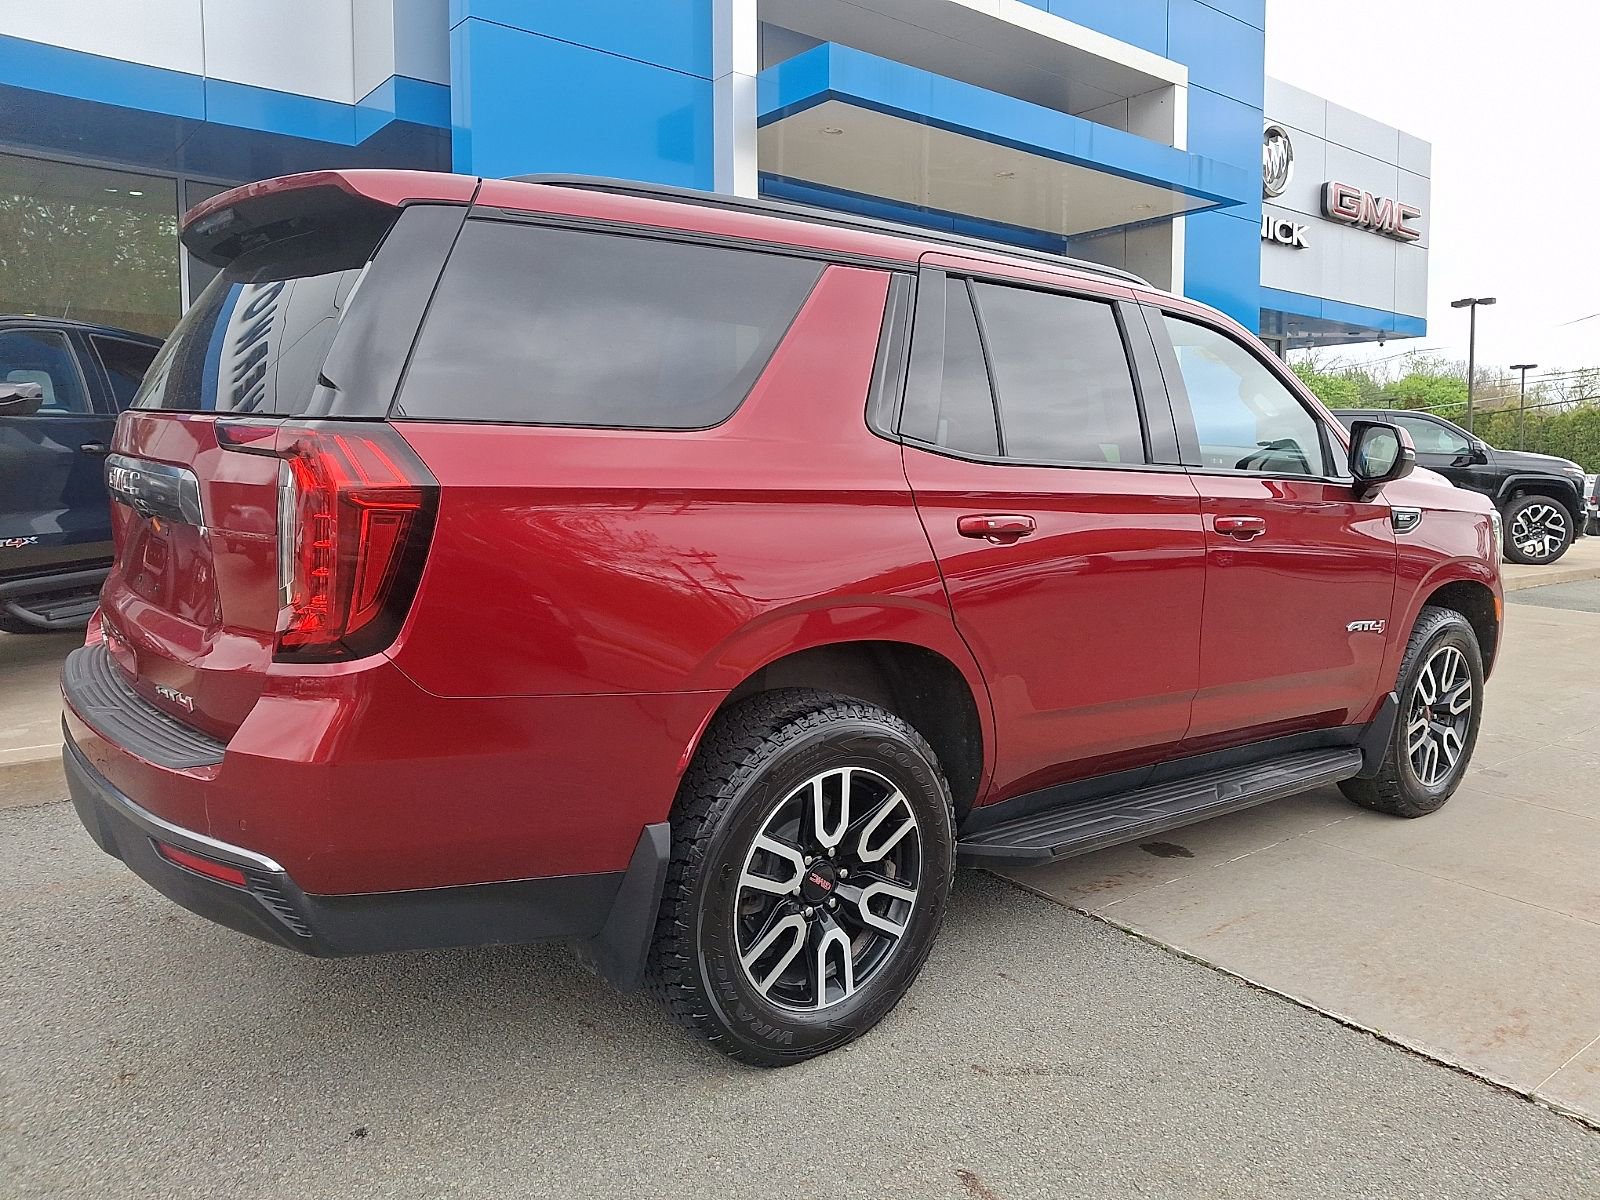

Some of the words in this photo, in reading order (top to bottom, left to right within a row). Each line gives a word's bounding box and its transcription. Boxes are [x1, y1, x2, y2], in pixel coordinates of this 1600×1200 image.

[1321, 180, 1422, 242] GMC
[1346, 620, 1386, 634] AT4
[155, 684, 194, 713] AT4
[809, 872, 832, 891] GMC
